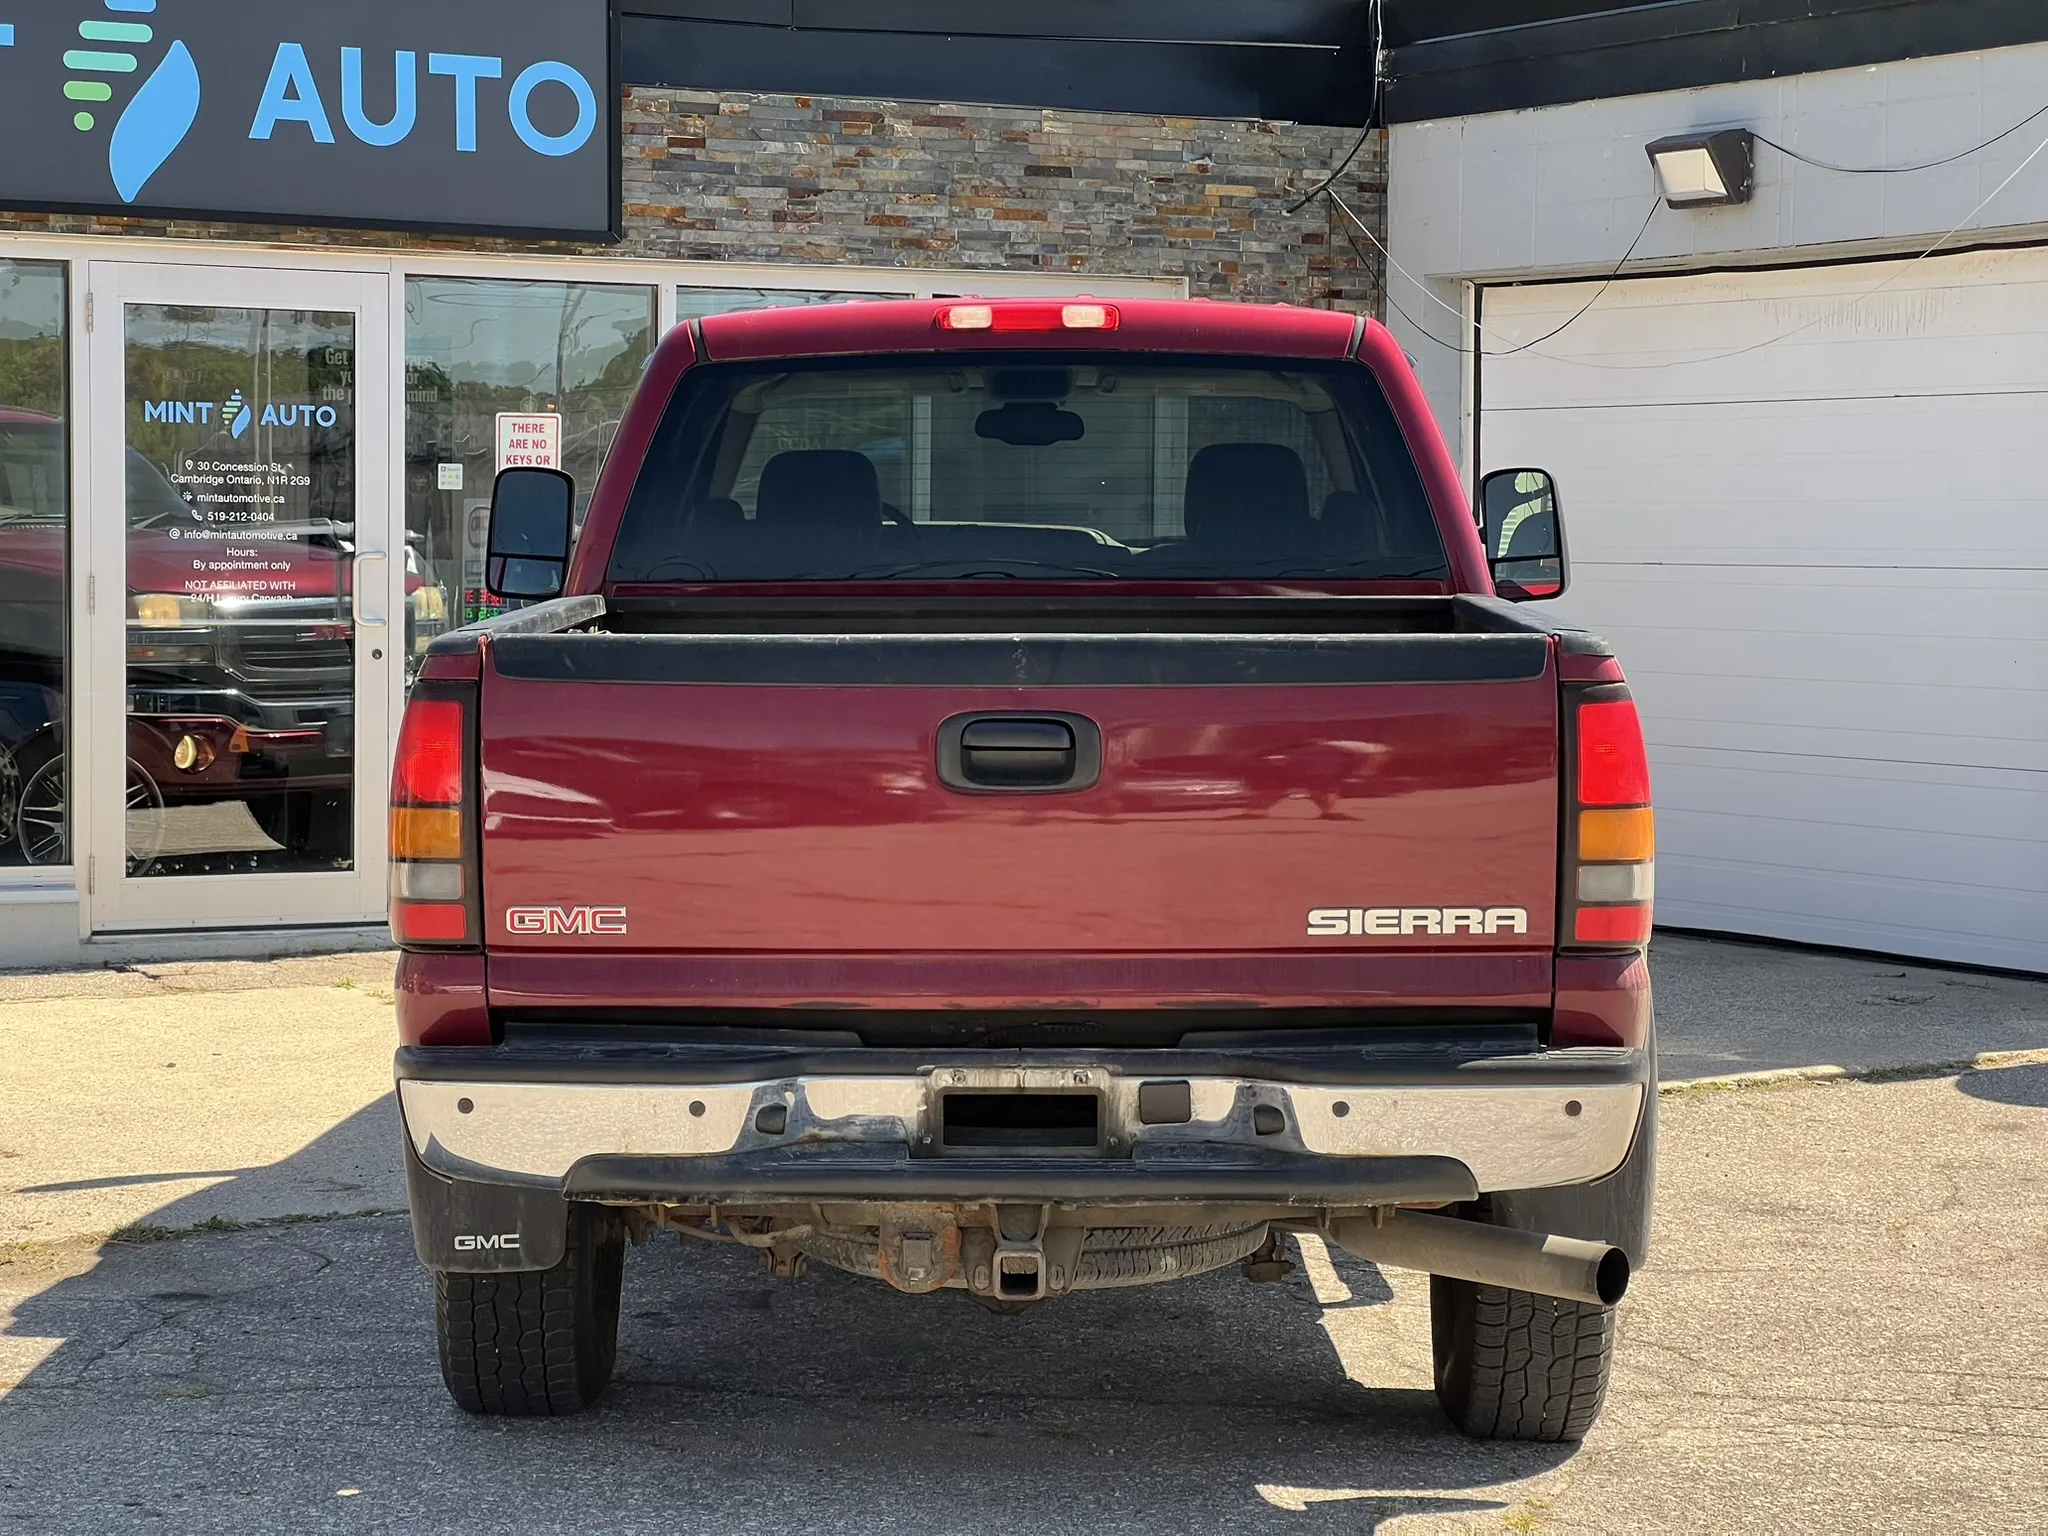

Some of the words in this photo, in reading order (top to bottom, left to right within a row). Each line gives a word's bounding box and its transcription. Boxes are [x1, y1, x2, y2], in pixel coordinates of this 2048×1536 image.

[249, 42, 597, 156] AUTO
[325, 348, 348, 365] Get
[322, 384, 344, 401] the
[144, 400, 213, 424] MINT
[260, 403, 337, 428] AUTO
[511, 423, 545, 433] THERE
[508, 439, 528, 449] ARE
[532, 439, 547, 449] NO
[505, 454, 532, 465] KEYS
[535, 455, 550, 465] OR
[197, 461, 210, 471] 30
[212, 461, 269, 472] Concession
[170, 474, 224, 486] Cambridge
[226, 475, 265, 486] Ontario,
[267, 475, 288, 485] N1R
[290, 476, 311, 485] 2G9
[197, 493, 285, 503] mintautomotive.ca
[207, 511, 275, 521] 519-212-0404
[184, 529, 298, 540] info@mintautomotive.ca
[226, 547, 258, 557] Hours:
[193, 560, 206, 571] By
[208, 561, 269, 571] appointment
[270, 561, 291, 571] only
[185, 580, 207, 590] NOT
[209, 580, 267, 590] AFFILIATED
[269, 581, 296, 590] WITH
[506, 906, 627, 934] GMC
[1307, 908, 1528, 935] SIERRA
[454, 1234, 520, 1250] GMC
